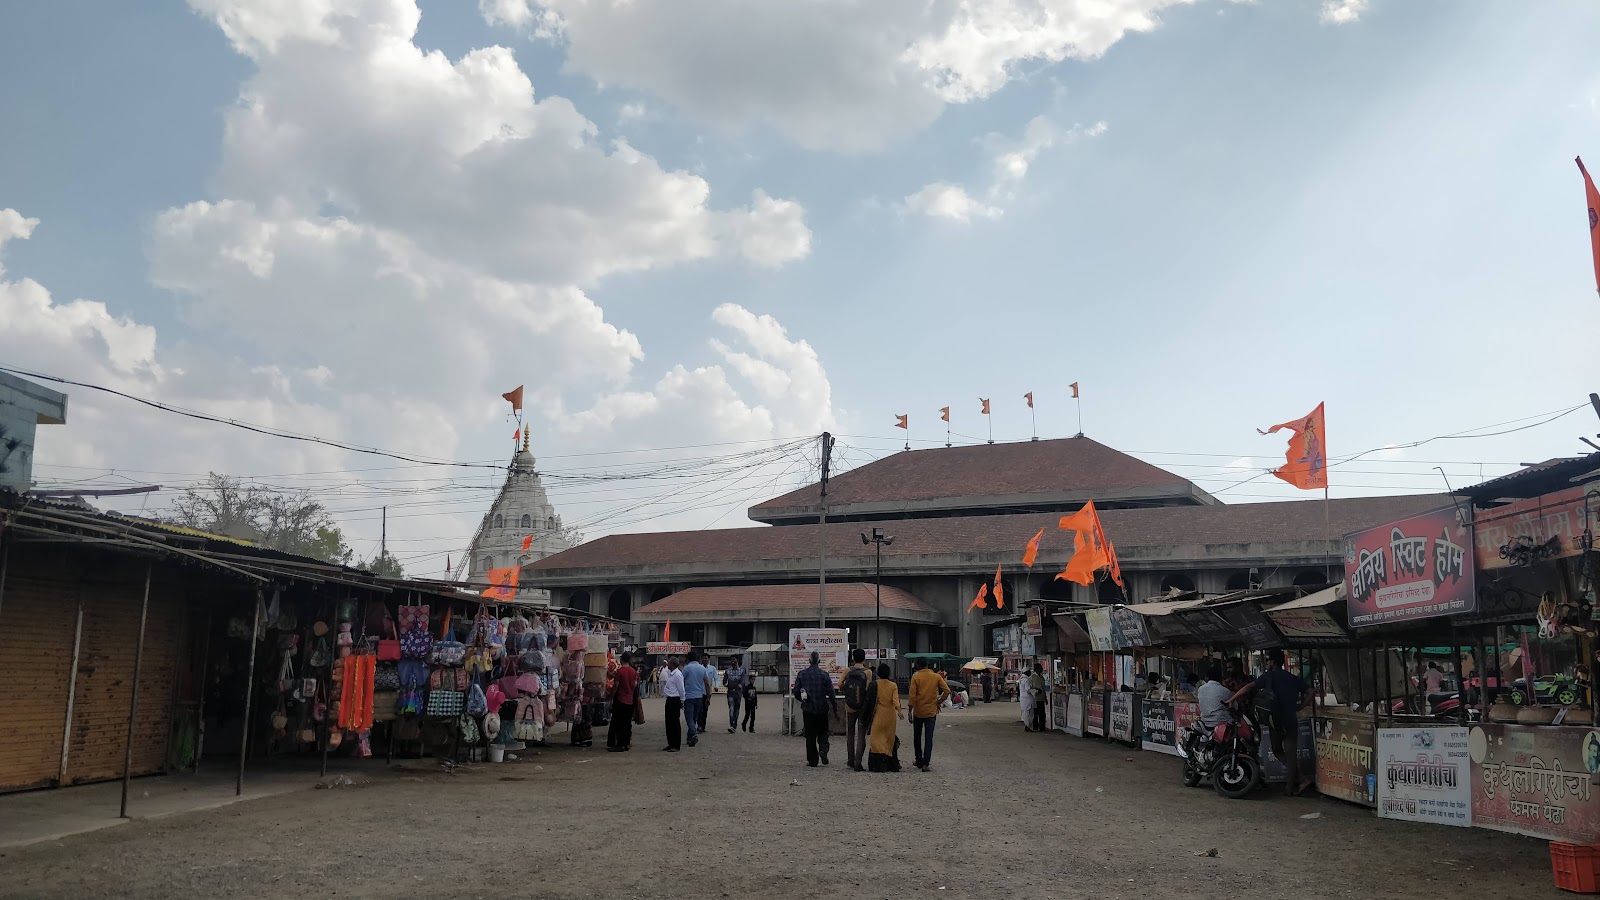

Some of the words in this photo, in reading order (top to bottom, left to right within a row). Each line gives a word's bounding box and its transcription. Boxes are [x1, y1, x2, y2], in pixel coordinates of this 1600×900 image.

[1351, 546, 1387, 601] क्षत्रिय
[1390, 526, 1428, 575] स्विट
[1435, 526, 1466, 584] होम
[820, 636, 843, 645] महोत्सव
[1349, 770, 1364, 787] पेढा
[1510, 789, 1540, 821] फेमस
[1543, 796, 1565, 825] पेढा
